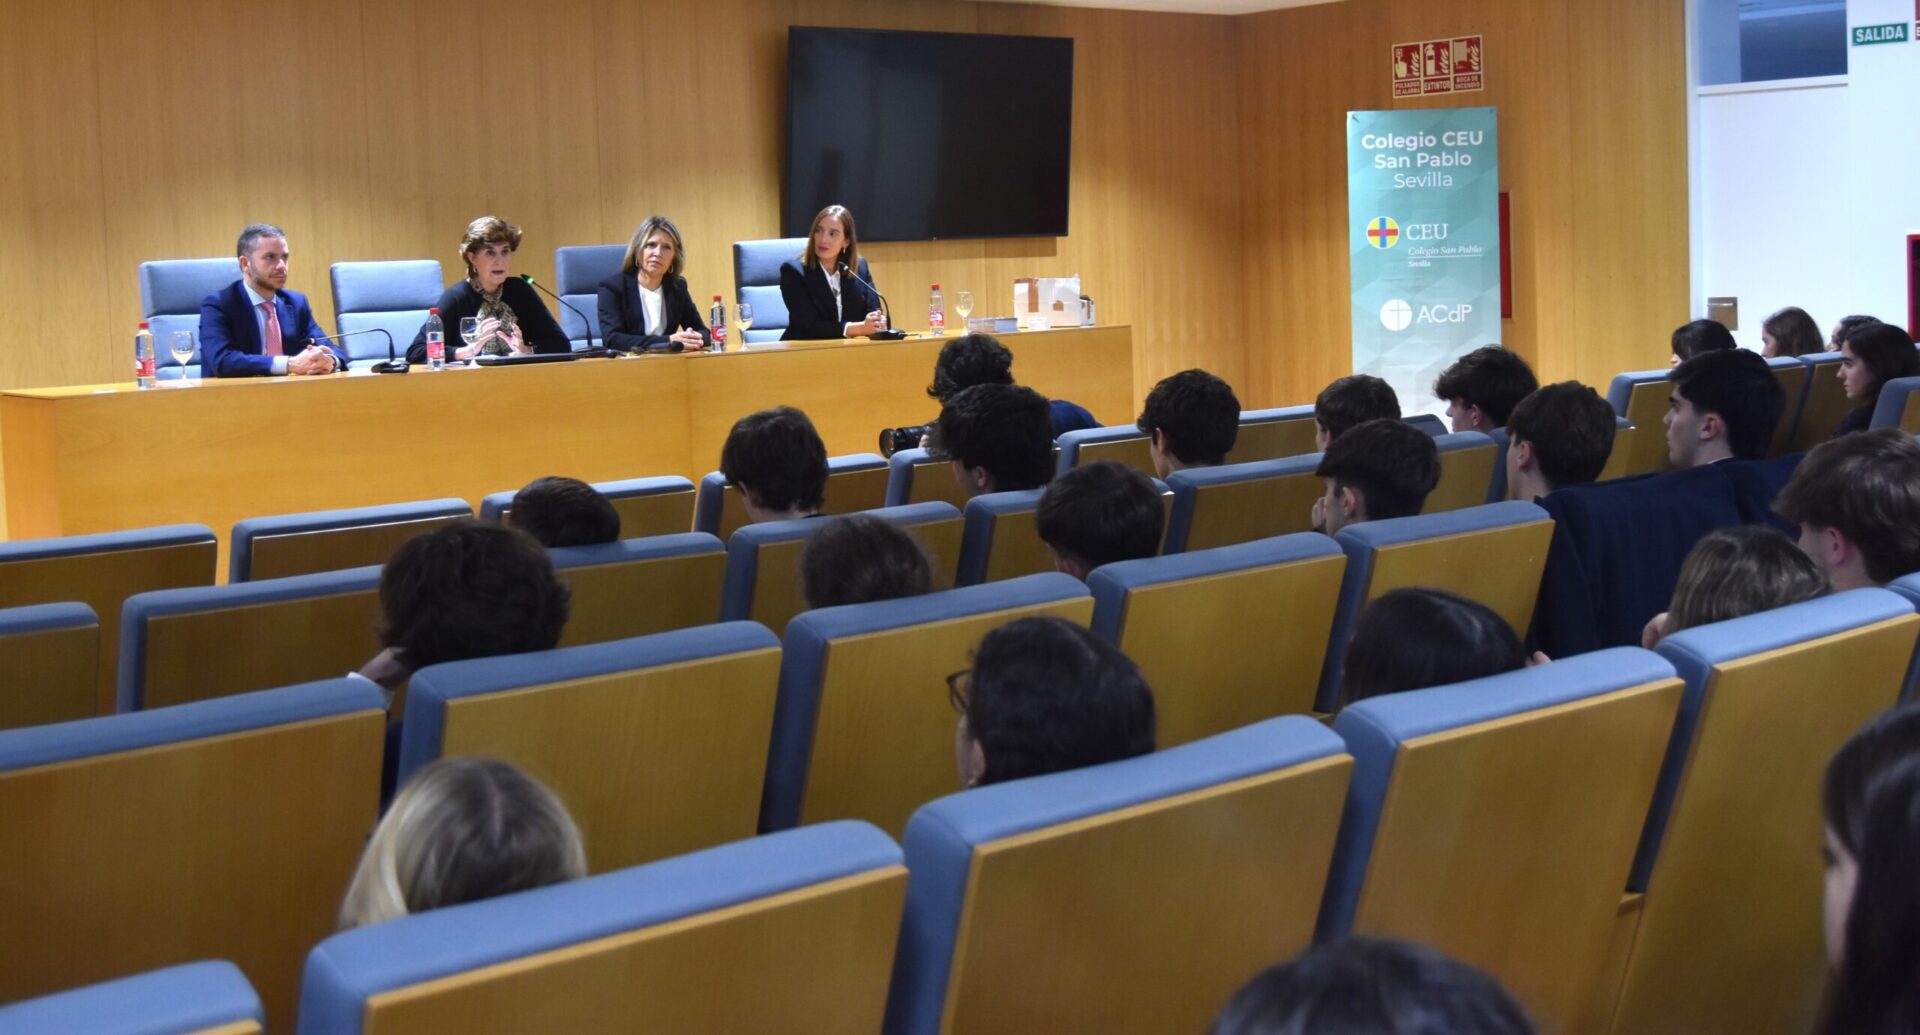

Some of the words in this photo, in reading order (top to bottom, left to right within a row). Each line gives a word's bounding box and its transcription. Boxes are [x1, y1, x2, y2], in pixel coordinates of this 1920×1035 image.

[1856, 25, 1904, 42] SALIDA
[1424, 80, 1450, 91] EXTINTOR
[1361, 131, 1437, 151] Colegio
[1442, 131, 1483, 146] CEU
[1374, 154, 1411, 169] San
[1416, 151, 1472, 168] Pablo
[1393, 171, 1453, 189] Sevilla
[1406, 223, 1448, 241] CEU
[1408, 247, 1439, 258] Colegio
[1440, 246, 1456, 254] San
[1458, 244, 1482, 254] Pablo
[1408, 260, 1431, 268] Sevilla
[1417, 303, 1473, 324] ACdP
